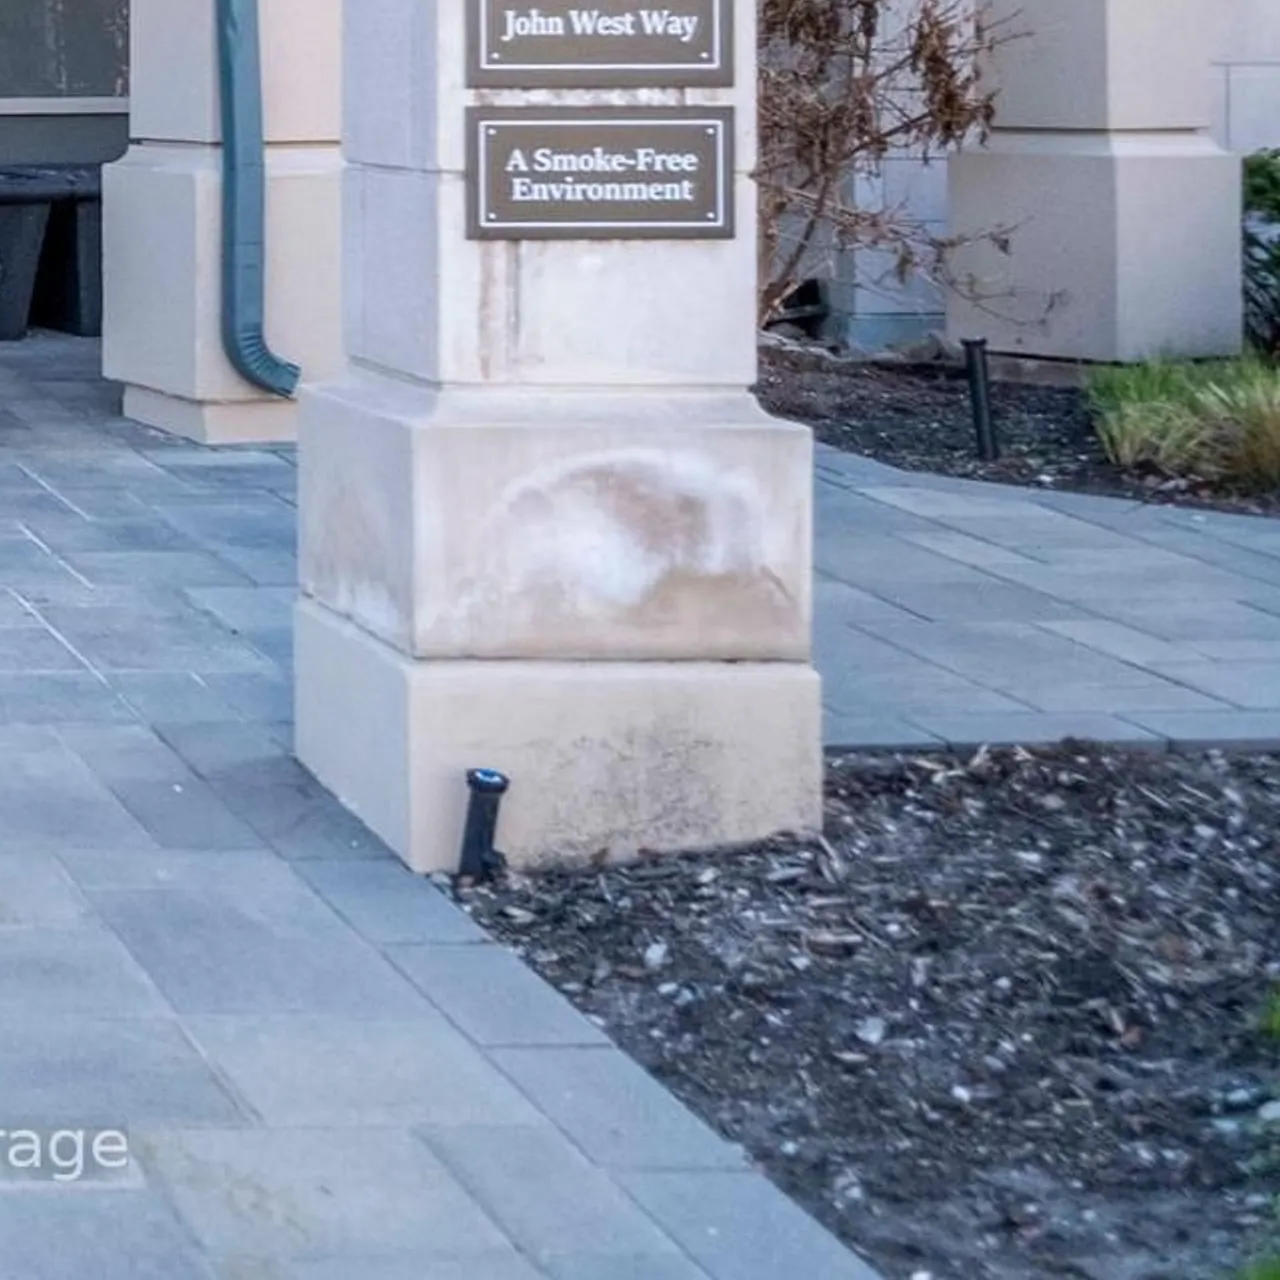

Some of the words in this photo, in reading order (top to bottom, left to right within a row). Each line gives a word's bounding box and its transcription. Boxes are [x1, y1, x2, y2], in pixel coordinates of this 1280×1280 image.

[502, 10, 564, 41] John
[570, 10, 634, 36] West
[640, 11, 698, 41] Way
[506, 149, 528, 172] A
[534, 148, 698, 172] Smoke-Free
[512, 177, 693, 201] Environment
